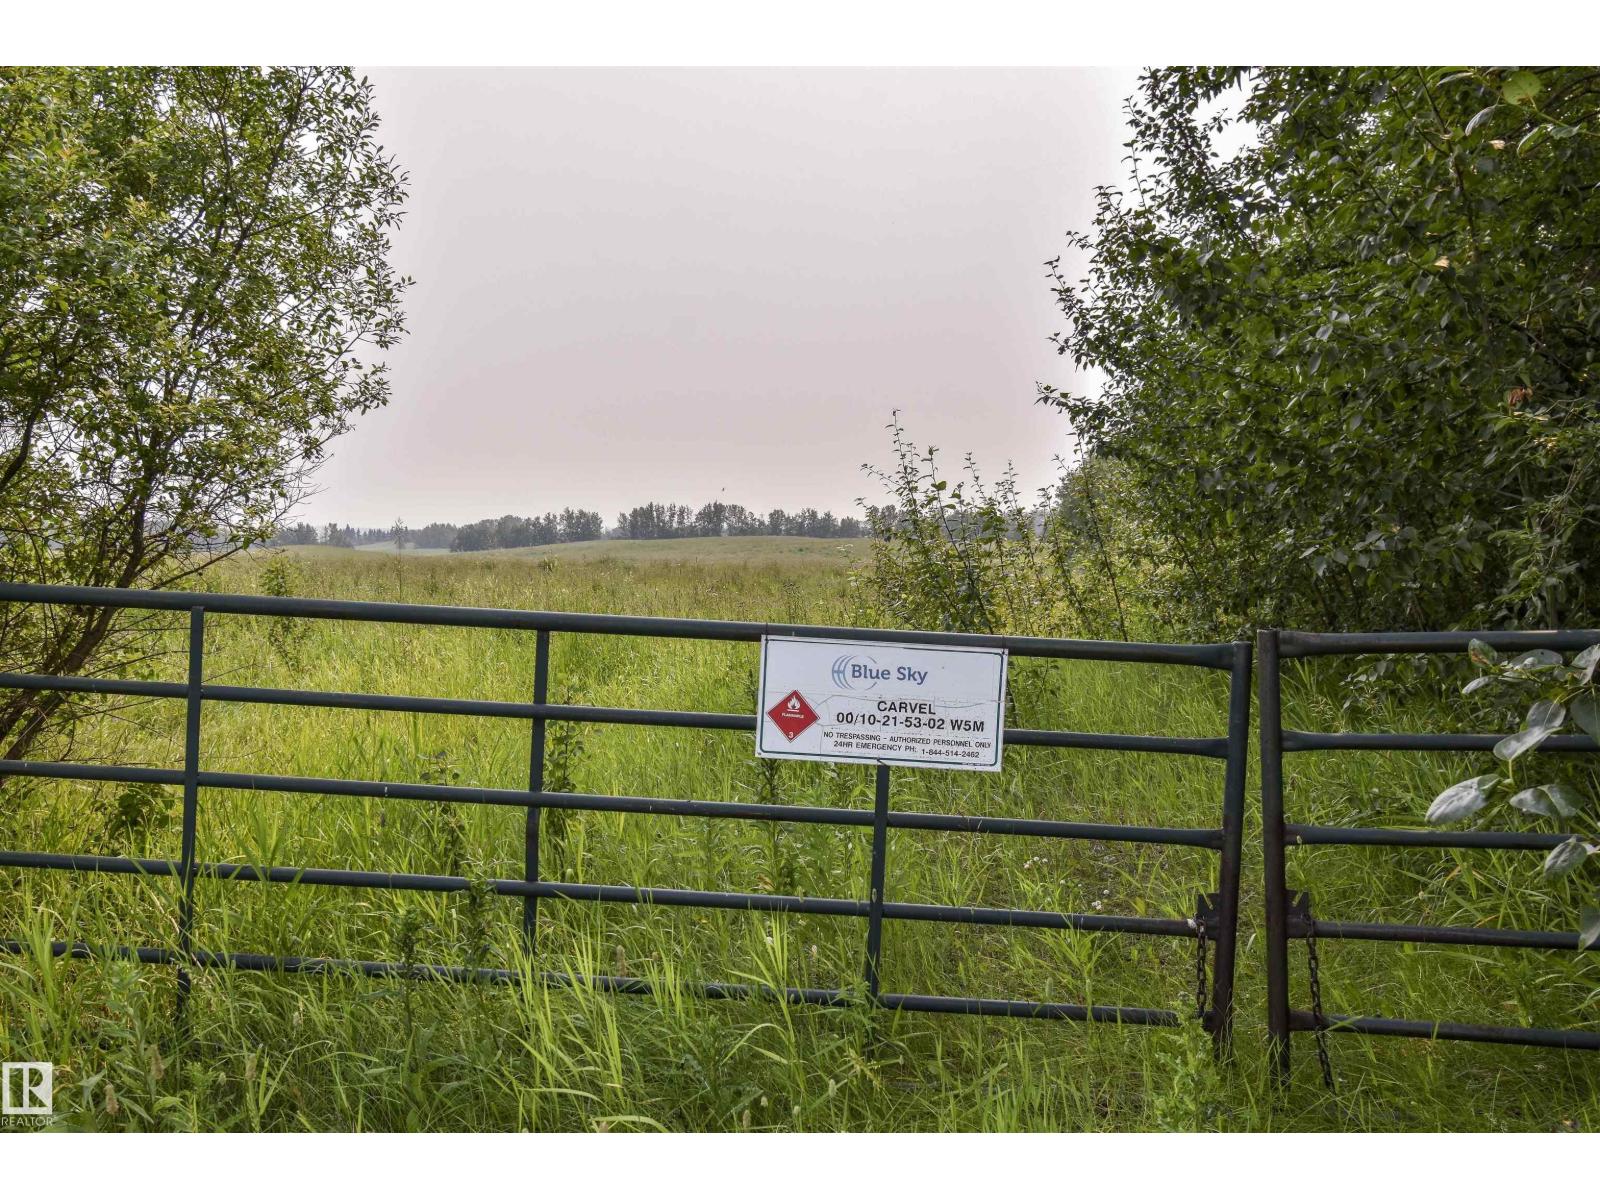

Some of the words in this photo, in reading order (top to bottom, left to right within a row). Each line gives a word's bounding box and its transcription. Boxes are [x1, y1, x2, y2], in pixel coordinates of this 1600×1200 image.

[851, 664, 890, 680] Blue
[896, 667, 928, 685] Sky
[877, 700, 936, 715] CARVEL
[836, 711, 945, 730] 00/10-21-53-02
[950, 719, 985, 732] W5M
[788, 731, 794, 739] 3
[836, 732, 881, 742] TRESPASSING
[889, 736, 931, 745] AUTHORIZED
[933, 739, 973, 748] PERSONNEL
[975, 741, 992, 749] ONLY
[833, 740, 853, 748] 24HR
[856, 742, 902, 752] EMERGENCY
